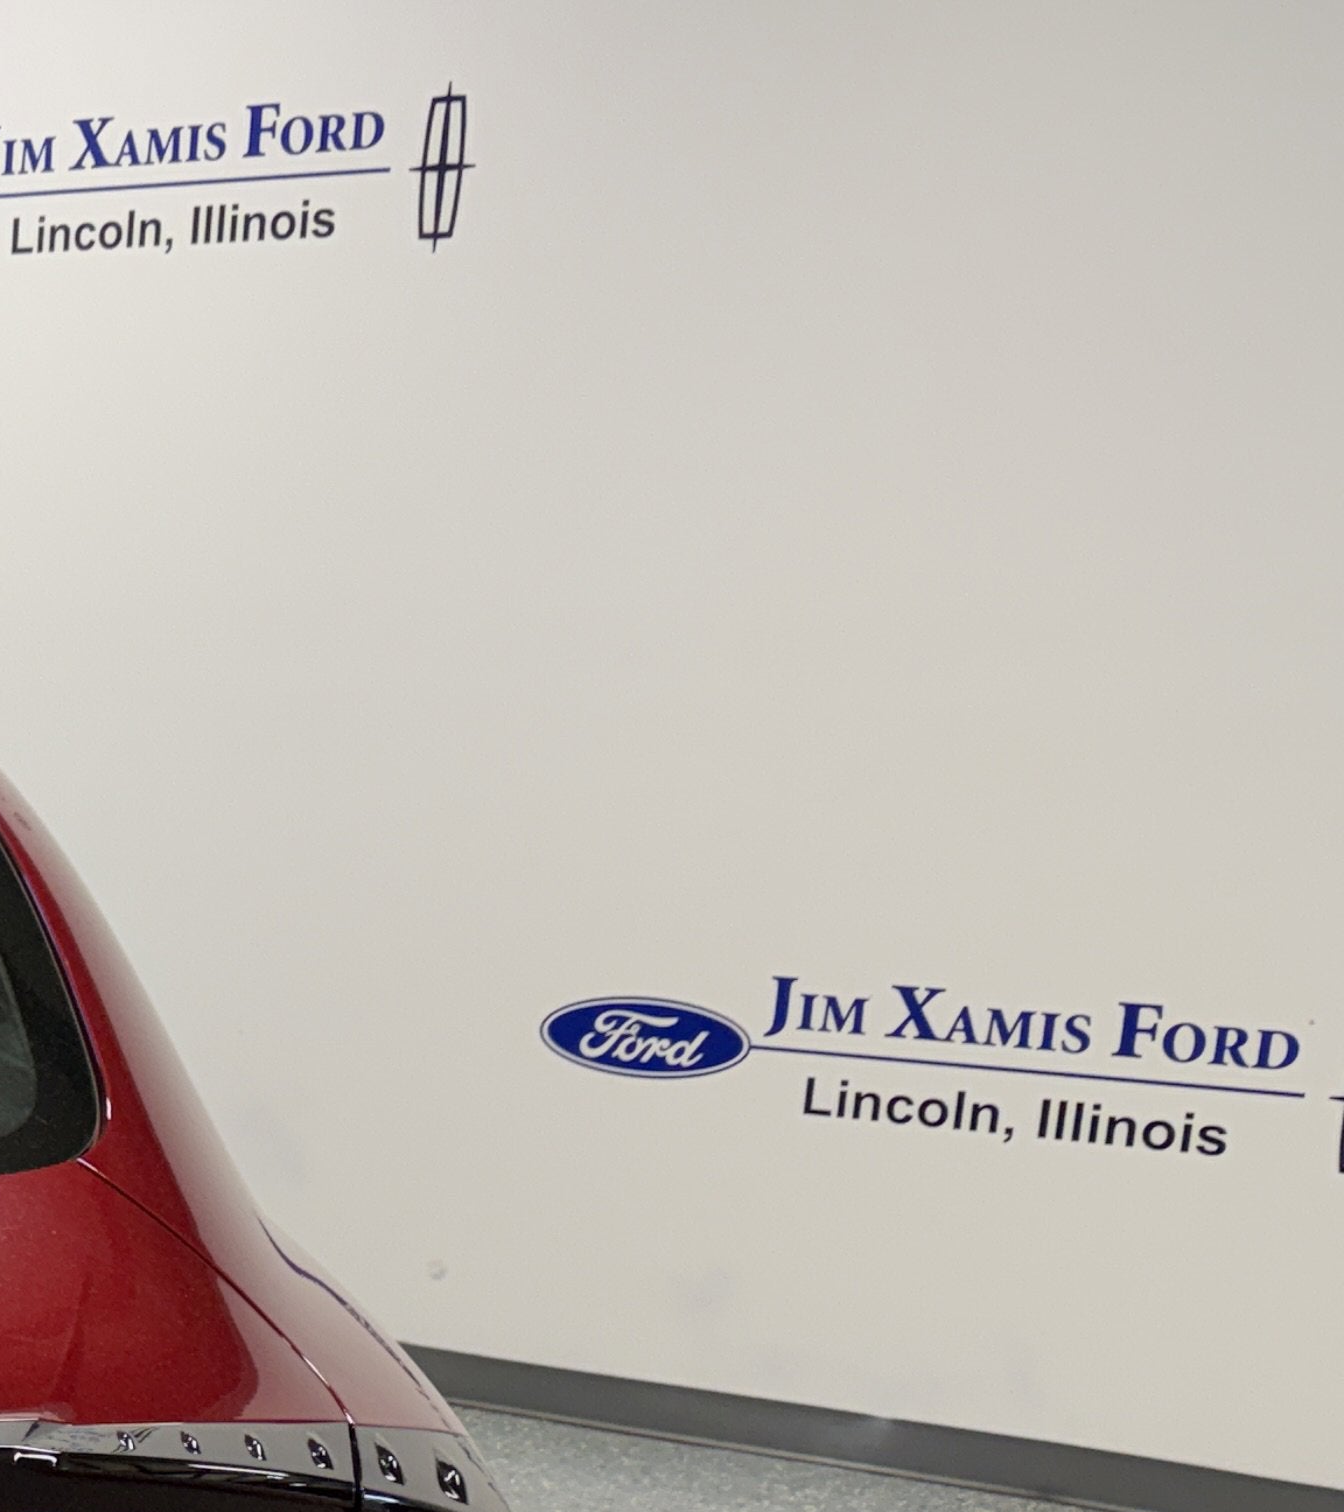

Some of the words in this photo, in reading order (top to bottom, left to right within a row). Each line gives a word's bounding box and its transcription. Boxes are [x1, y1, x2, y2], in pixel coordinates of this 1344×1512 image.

[68, 116, 227, 171] XAMIS
[242, 103, 385, 158] FORD
[11, 209, 174, 255] Lincoln,
[190, 199, 336, 246] Illinois
[578, 1008, 711, 1070] Ford
[763, 976, 870, 1038] JIM
[887, 985, 1092, 1054] XAMIS
[1111, 1002, 1301, 1071] FORD
[803, 1077, 1015, 1144] Lincoln,
[1037, 1098, 1228, 1157] Illinois
